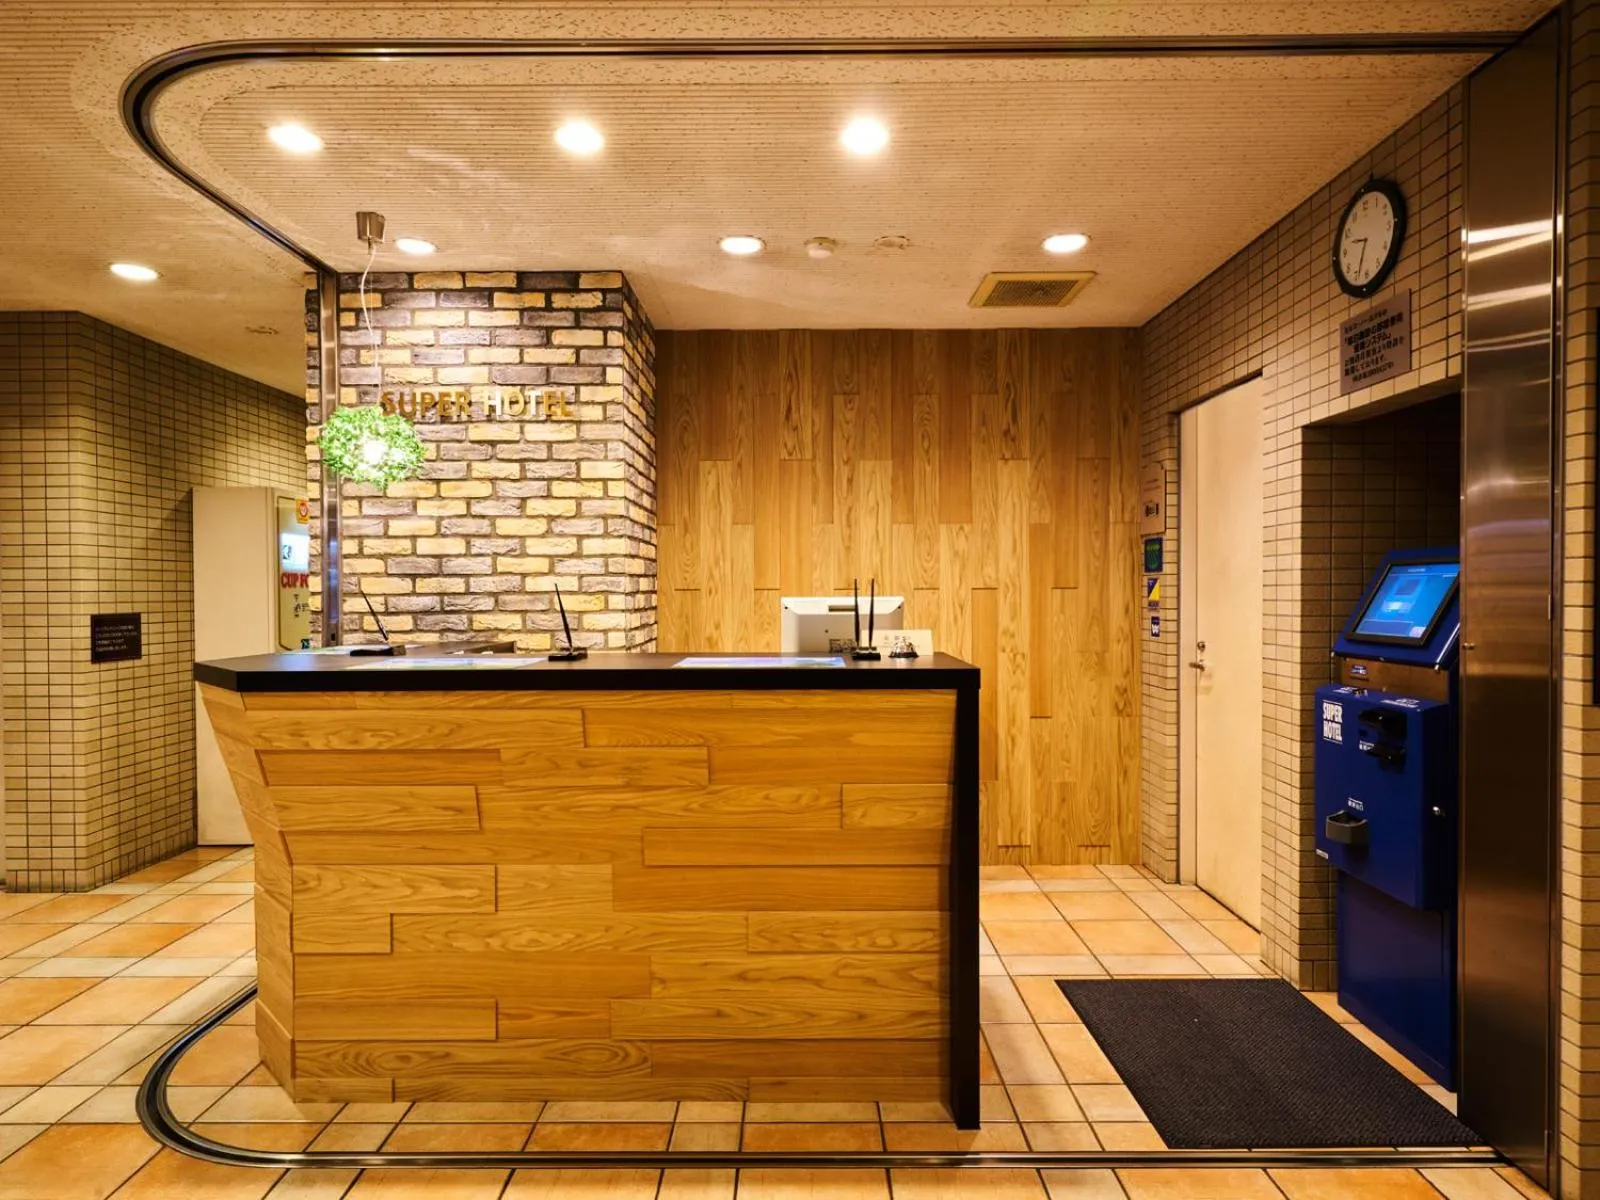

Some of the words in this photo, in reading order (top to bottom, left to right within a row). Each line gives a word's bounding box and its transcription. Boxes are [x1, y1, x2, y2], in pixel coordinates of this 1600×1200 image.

[380, 391, 472, 418] SUPER
[484, 389, 574, 417] HOTEL
[281, 572, 299, 588] CUP
[1323, 702, 1343, 723] SUPER
[1323, 720, 1343, 741] HOTEL
